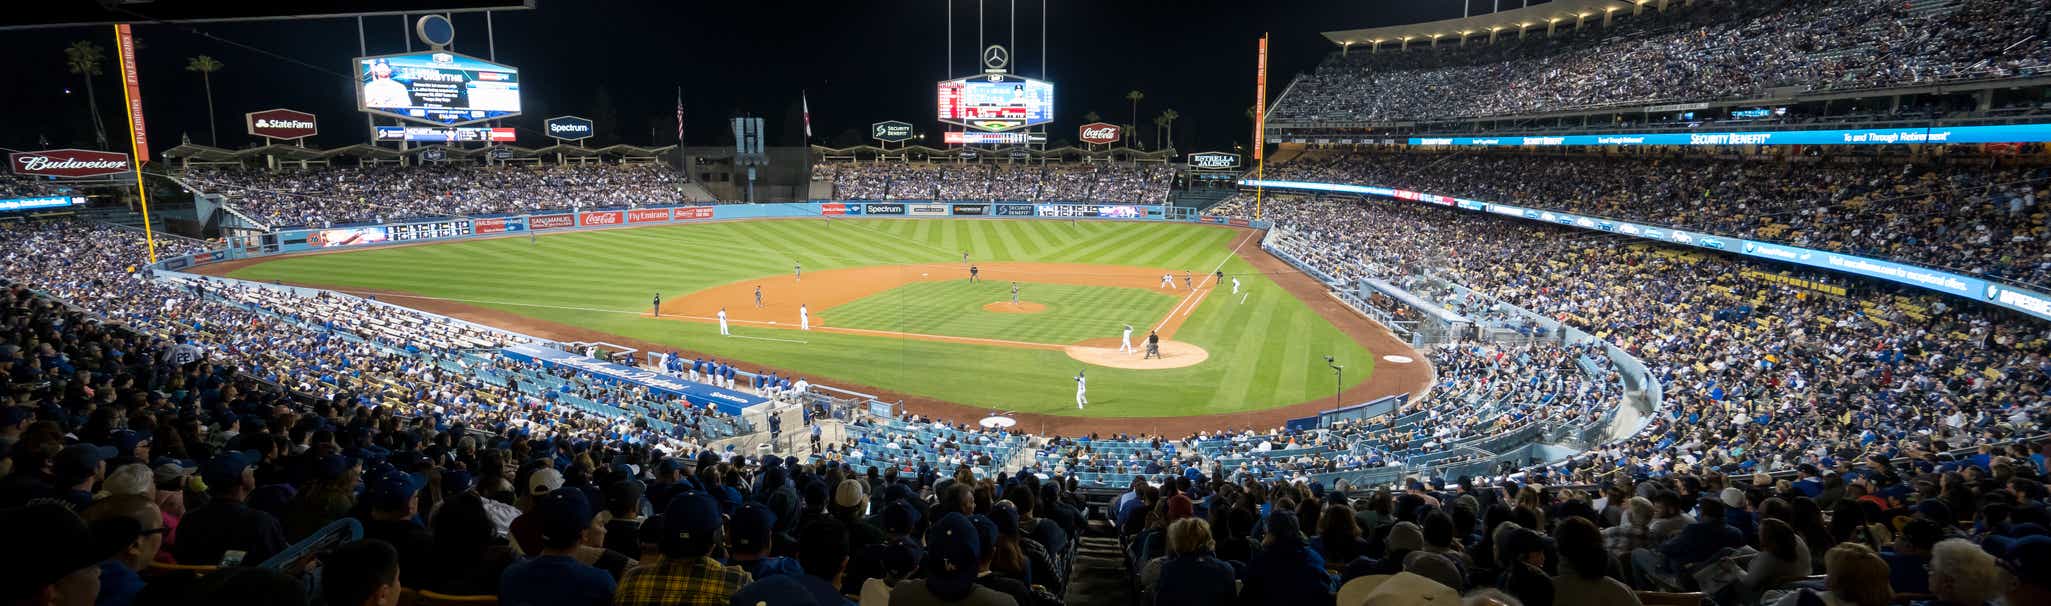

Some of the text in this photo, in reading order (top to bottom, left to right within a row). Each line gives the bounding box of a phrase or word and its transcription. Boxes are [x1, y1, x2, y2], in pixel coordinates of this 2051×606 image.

[551, 123, 587, 133] Spectrum
[1690, 133, 1727, 144] SECURITY
[1844, 133, 1851, 142] To
[1853, 133, 1866, 141] and
[1869, 133, 1898, 143] Through
[19, 156, 127, 170] Budweiser
[867, 204, 901, 214] Spectrum
[176, 352, 191, 363] 22
